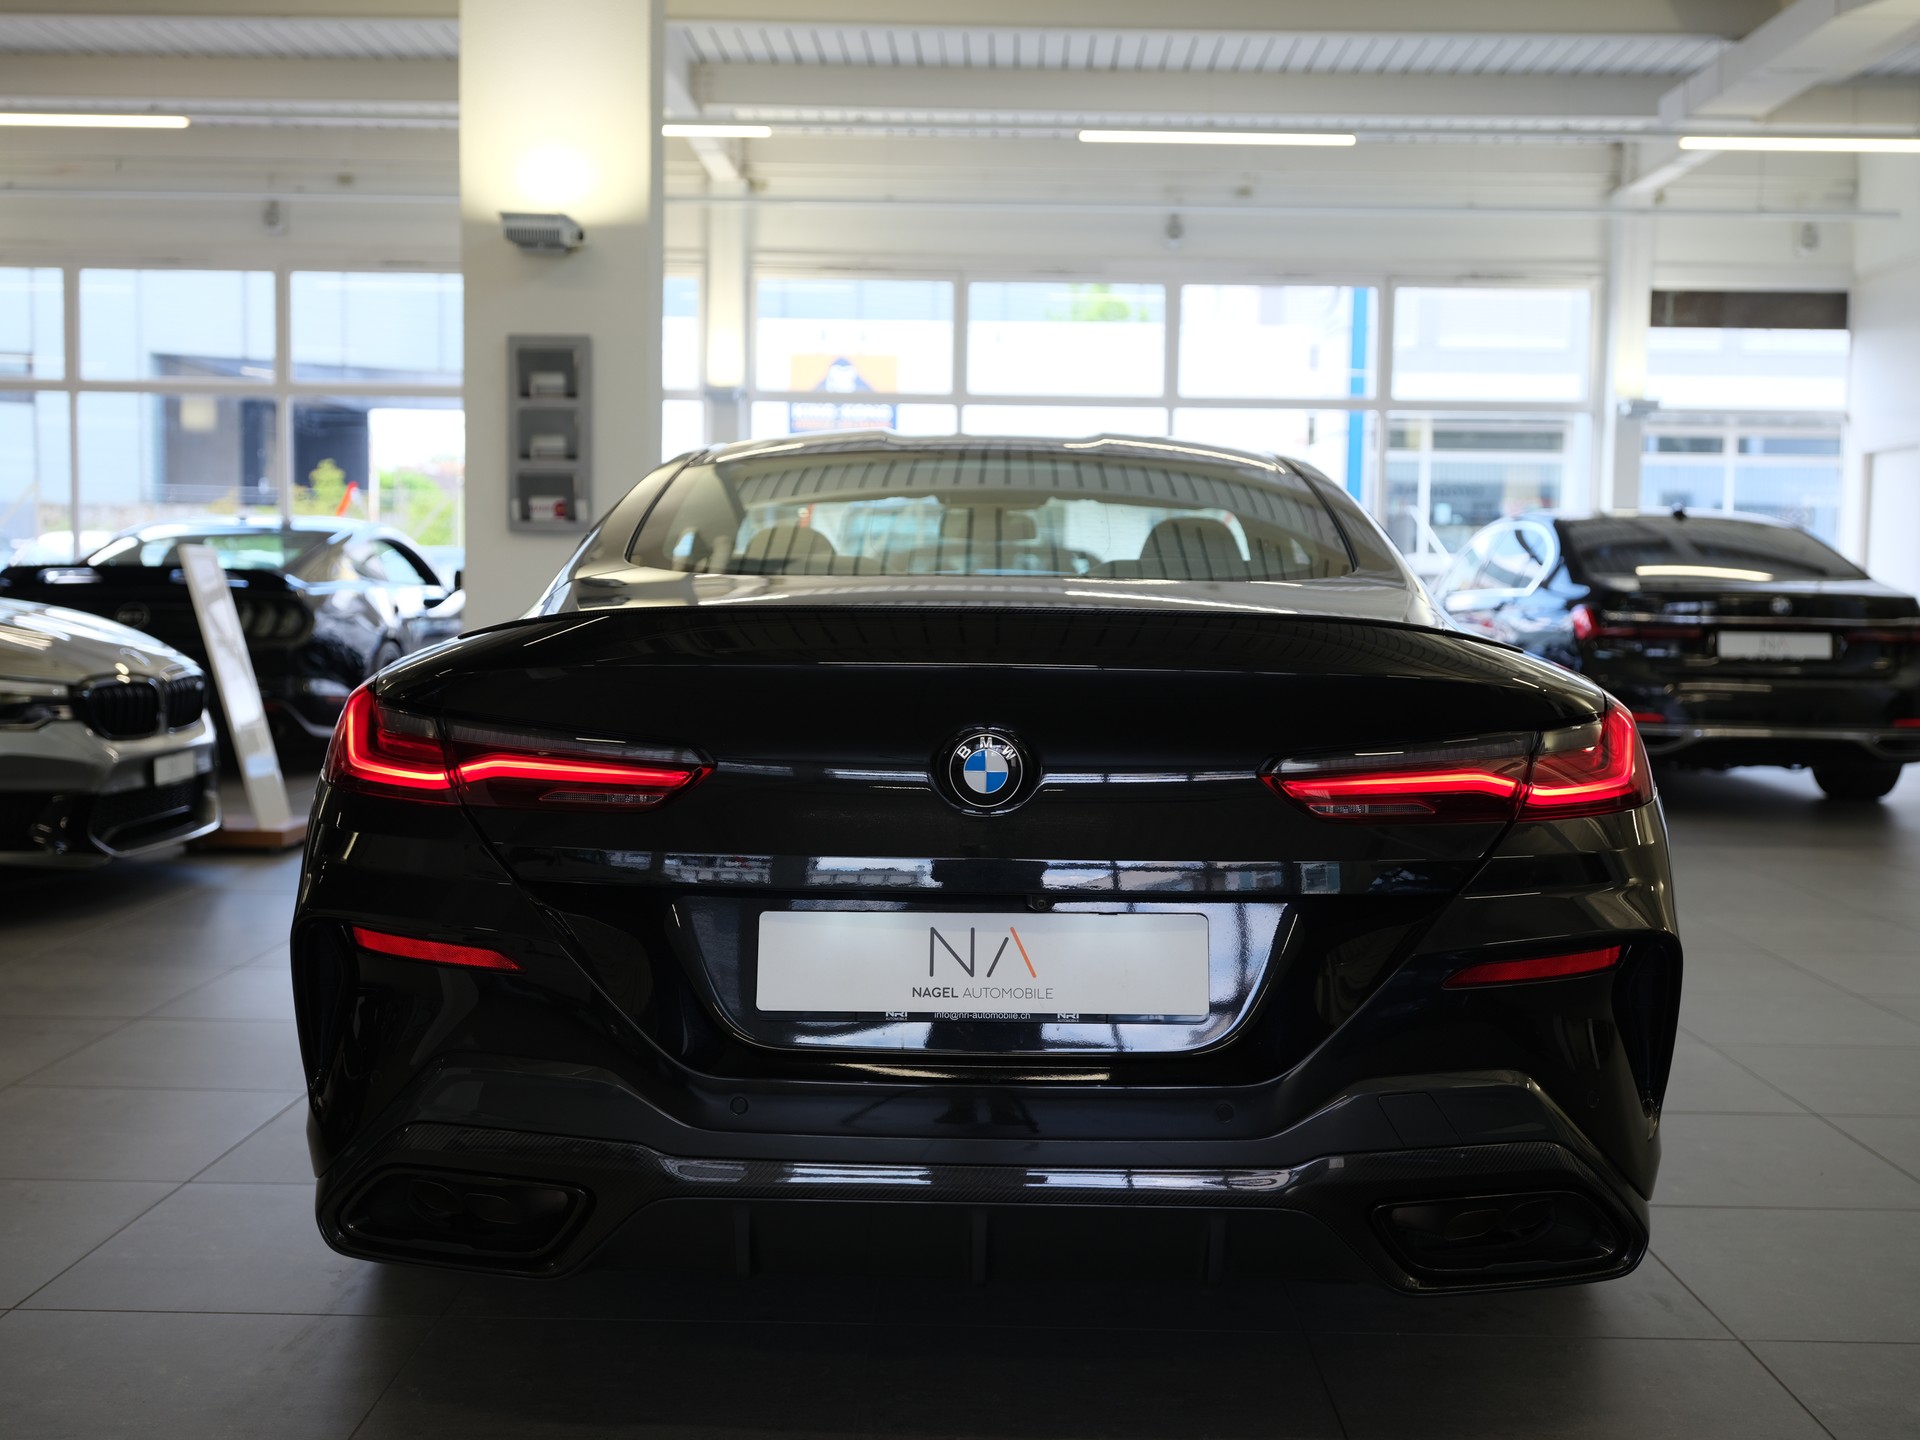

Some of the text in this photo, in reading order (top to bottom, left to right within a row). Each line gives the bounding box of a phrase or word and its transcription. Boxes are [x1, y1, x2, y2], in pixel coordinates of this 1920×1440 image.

[957, 737, 1017, 760] BMW
[912, 987, 1054, 1000] NAGEL AUTOMOBILE
